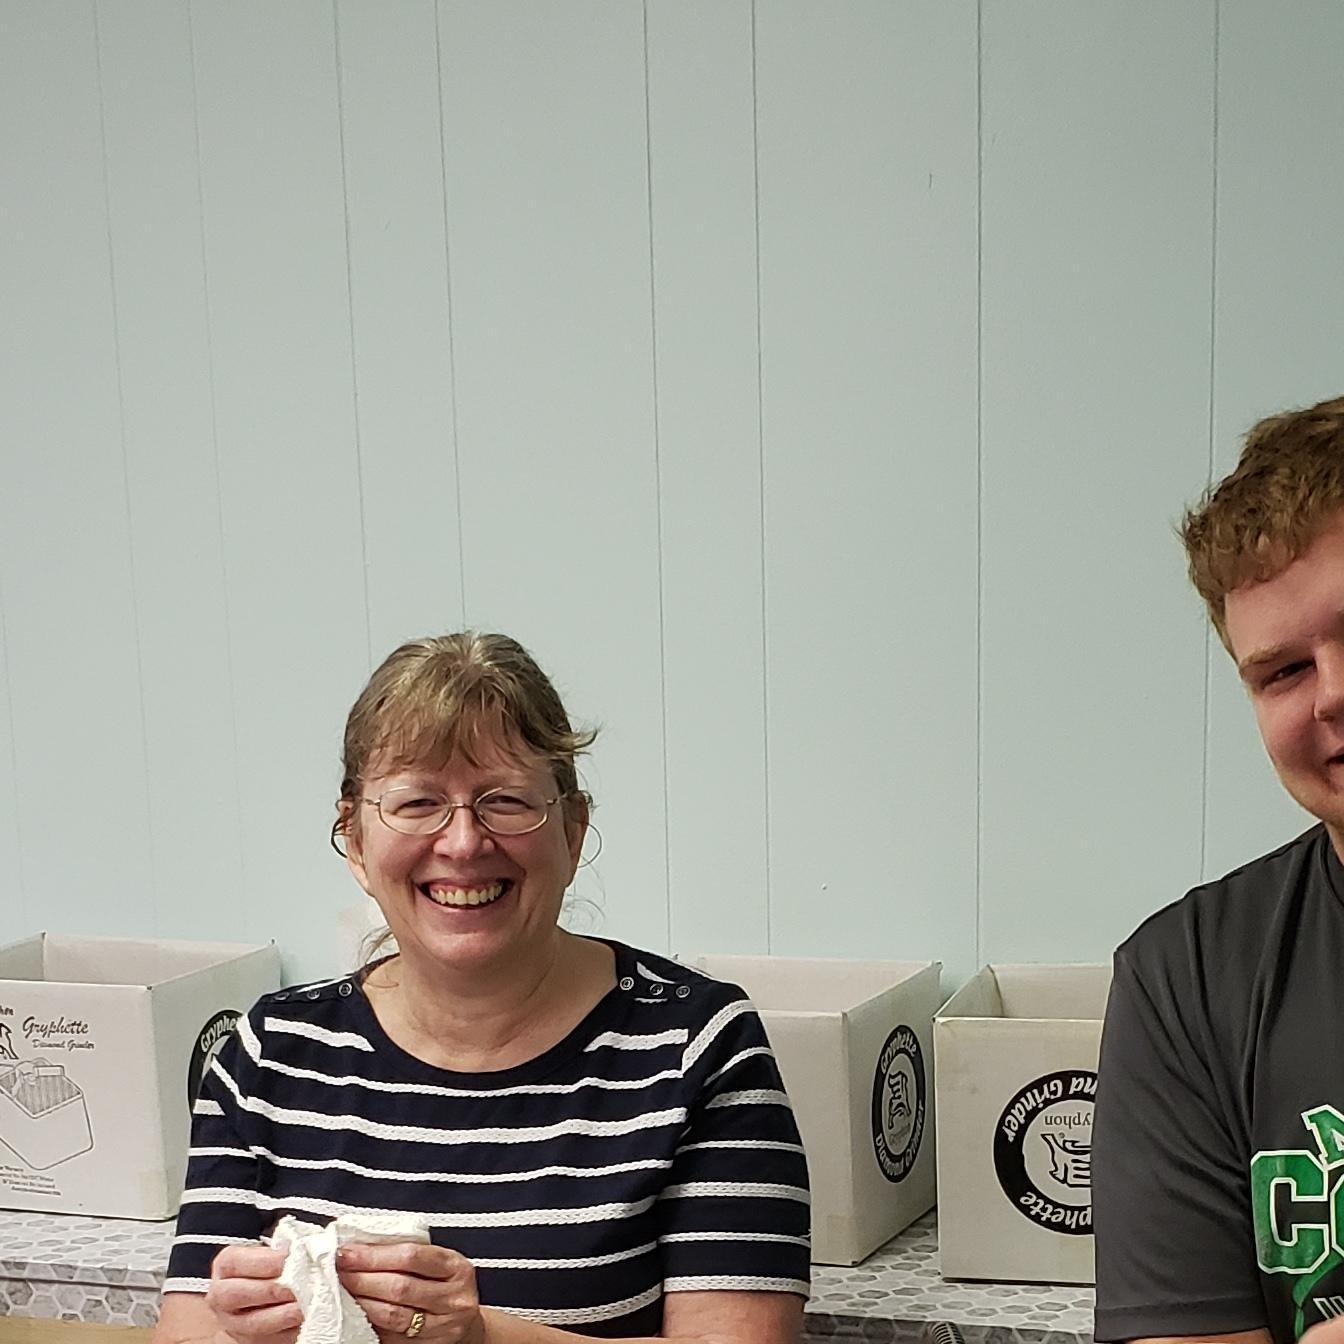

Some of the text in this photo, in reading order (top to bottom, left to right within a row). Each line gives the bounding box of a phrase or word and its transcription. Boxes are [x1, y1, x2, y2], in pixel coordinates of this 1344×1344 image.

[22, 1016, 89, 1039] Gryphette
[1002, 1079, 1063, 1143] Grinder
[1044, 1112, 1091, 1129] yphon
[1019, 1191, 1092, 1229] phette
